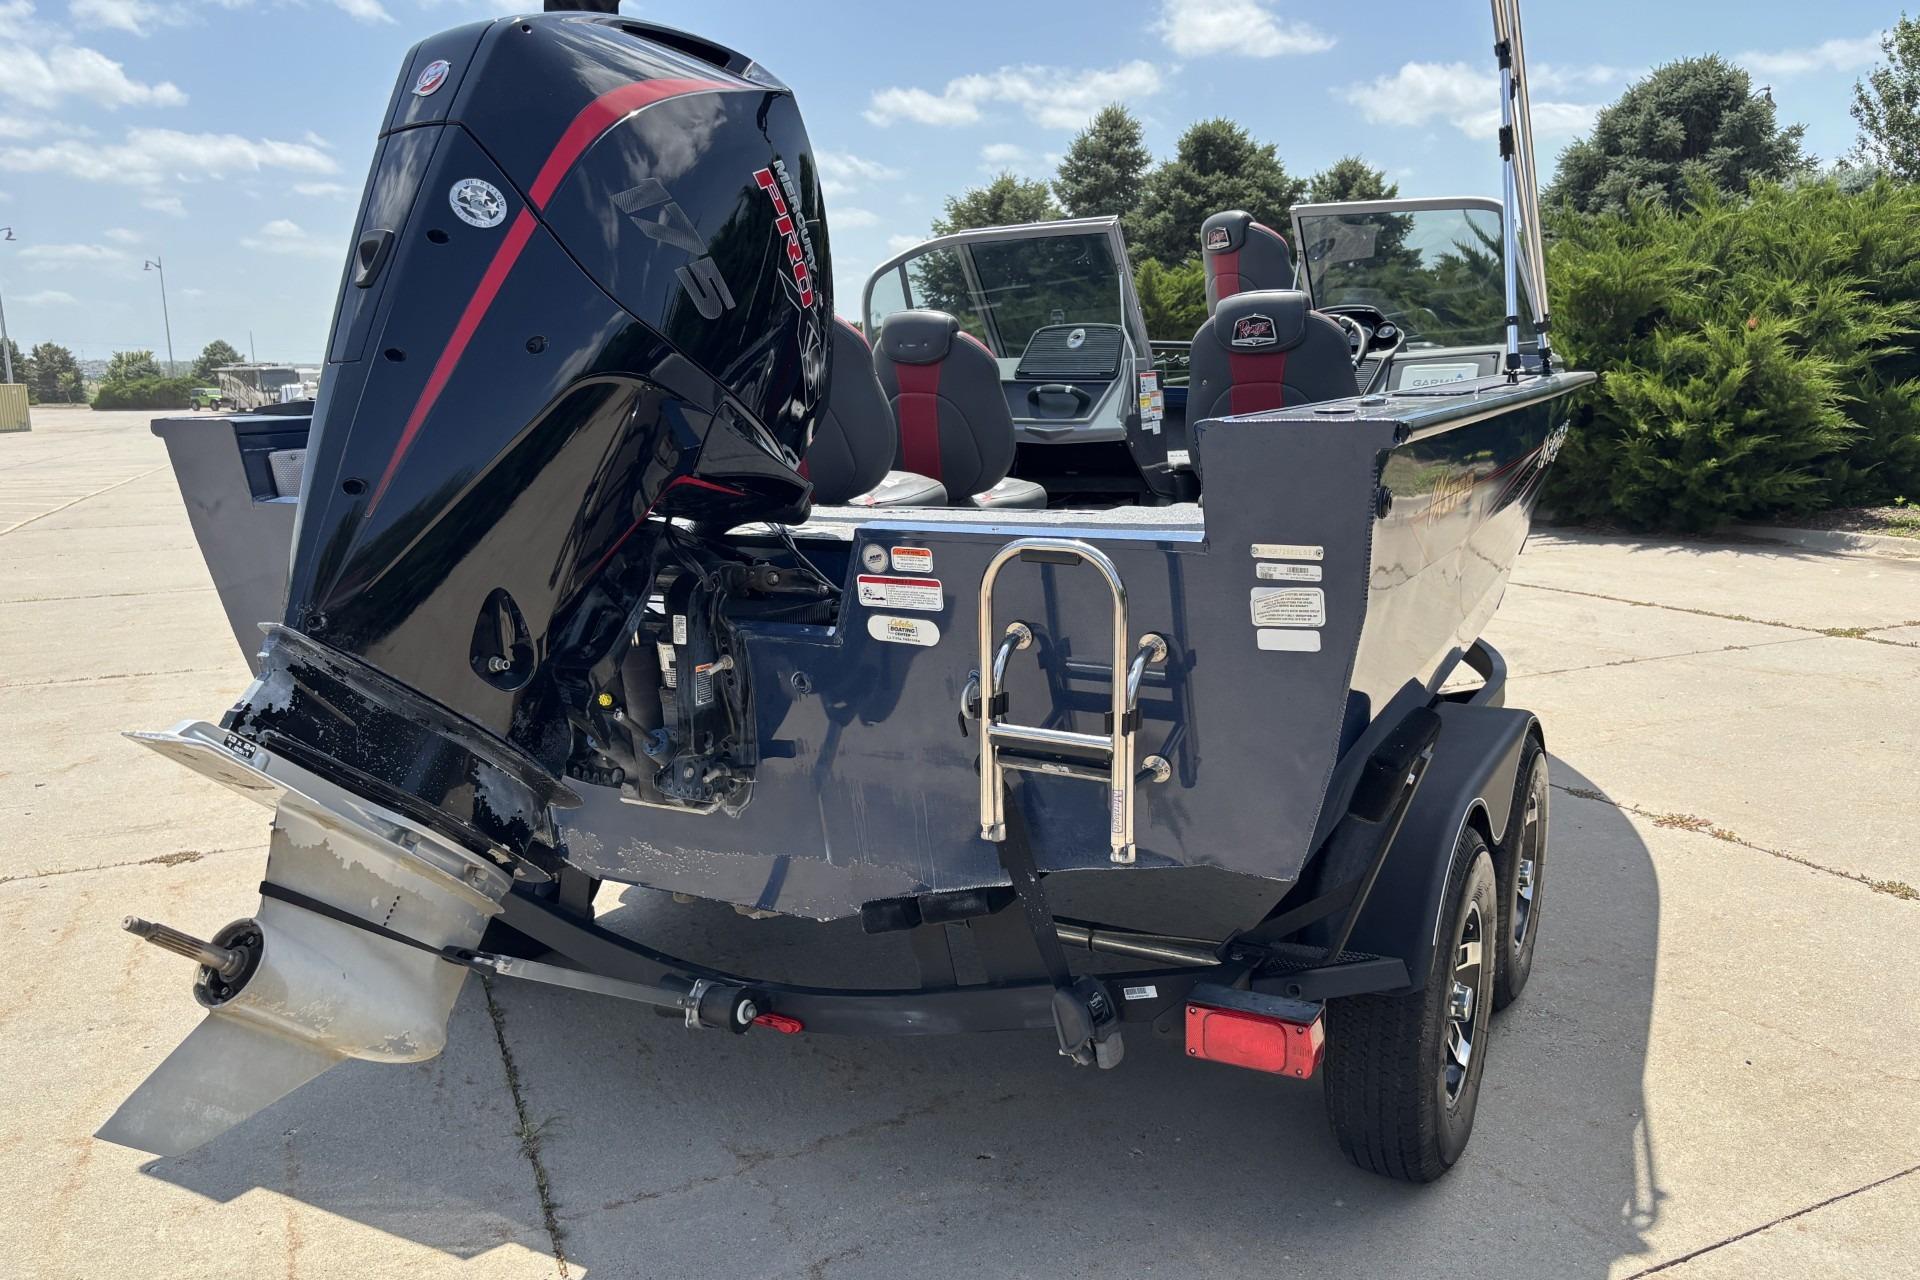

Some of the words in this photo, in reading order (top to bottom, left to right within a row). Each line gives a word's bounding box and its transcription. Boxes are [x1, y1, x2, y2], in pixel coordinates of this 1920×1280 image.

[609, 177, 736, 320] 175
[753, 167, 813, 308] PRO
[773, 160, 818, 273] MERCURY
[228, 735, 238, 744] 13
